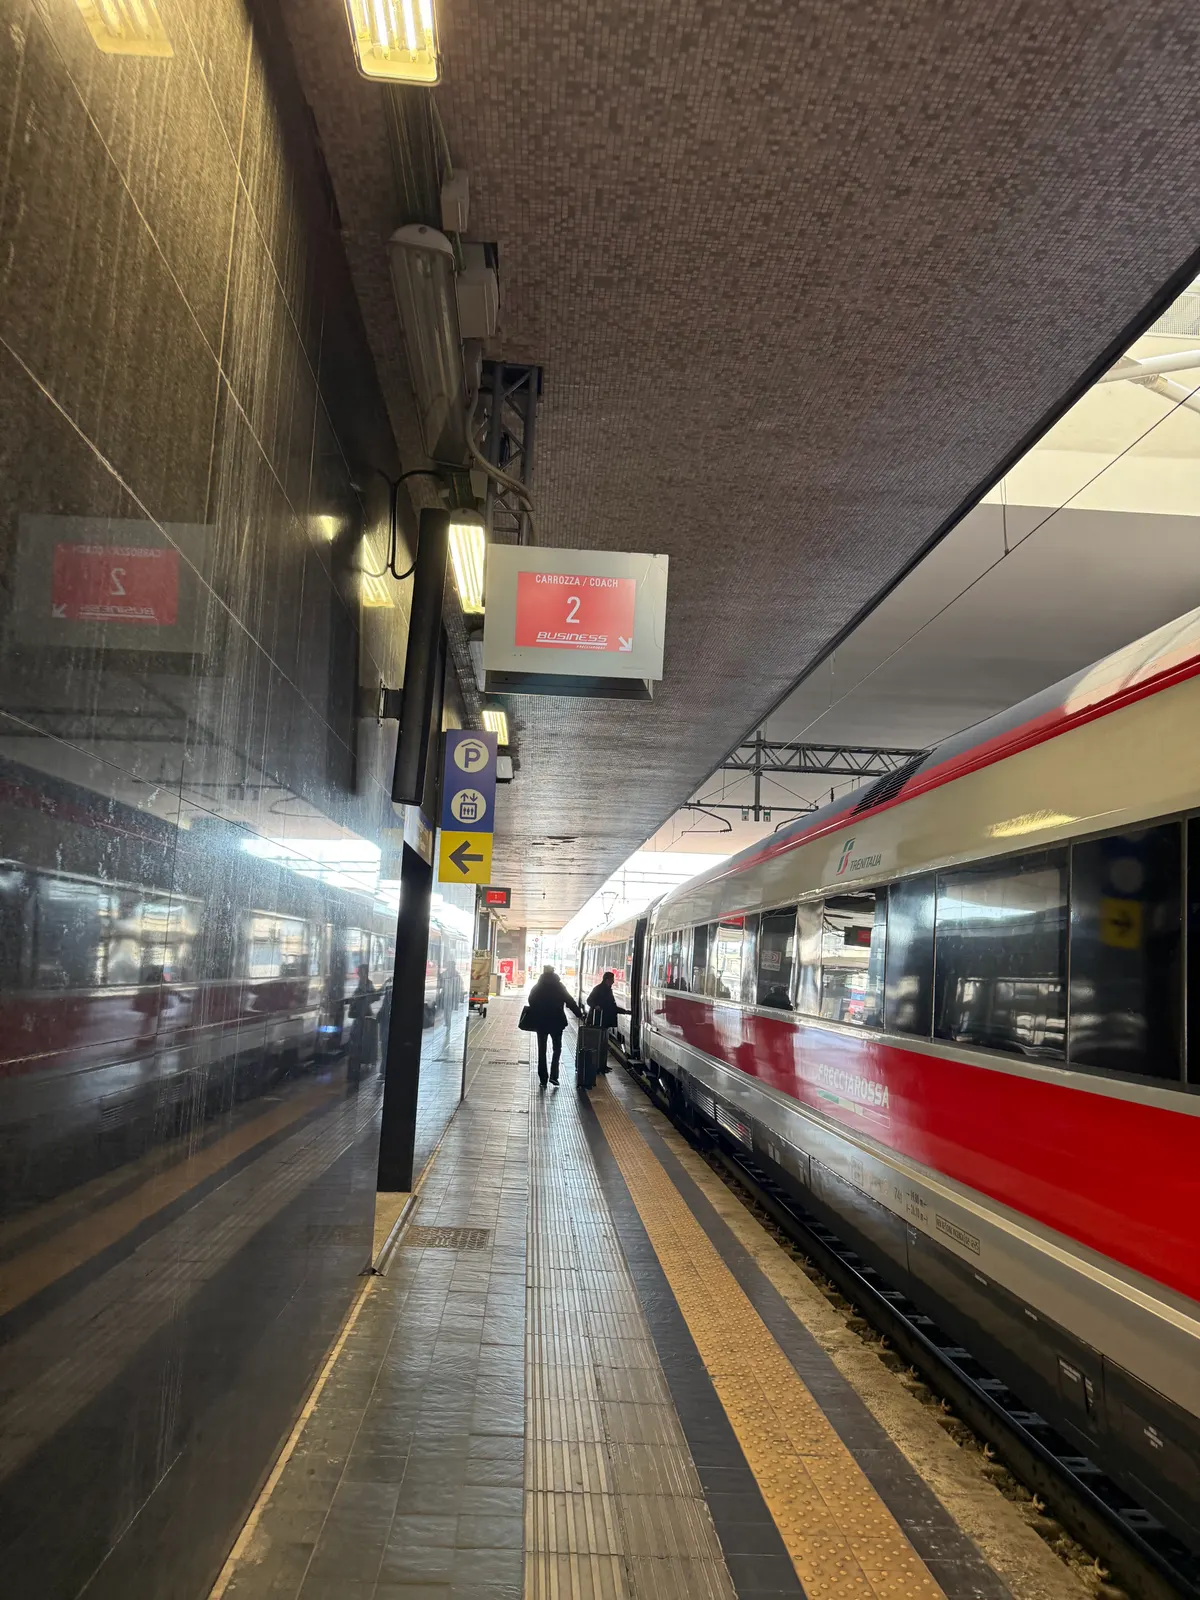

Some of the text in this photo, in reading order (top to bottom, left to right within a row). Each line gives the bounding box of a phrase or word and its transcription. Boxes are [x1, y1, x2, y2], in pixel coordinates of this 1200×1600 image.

[535, 574, 619, 588] CARROZZA / COACH
[565, 596, 581, 625] 2
[537, 631, 609, 643] BUSINESS
[464, 747, 481, 768] P
[849, 853, 882, 872] TRENITALIA
[817, 1063, 890, 1110] FRECCIAROSSA
